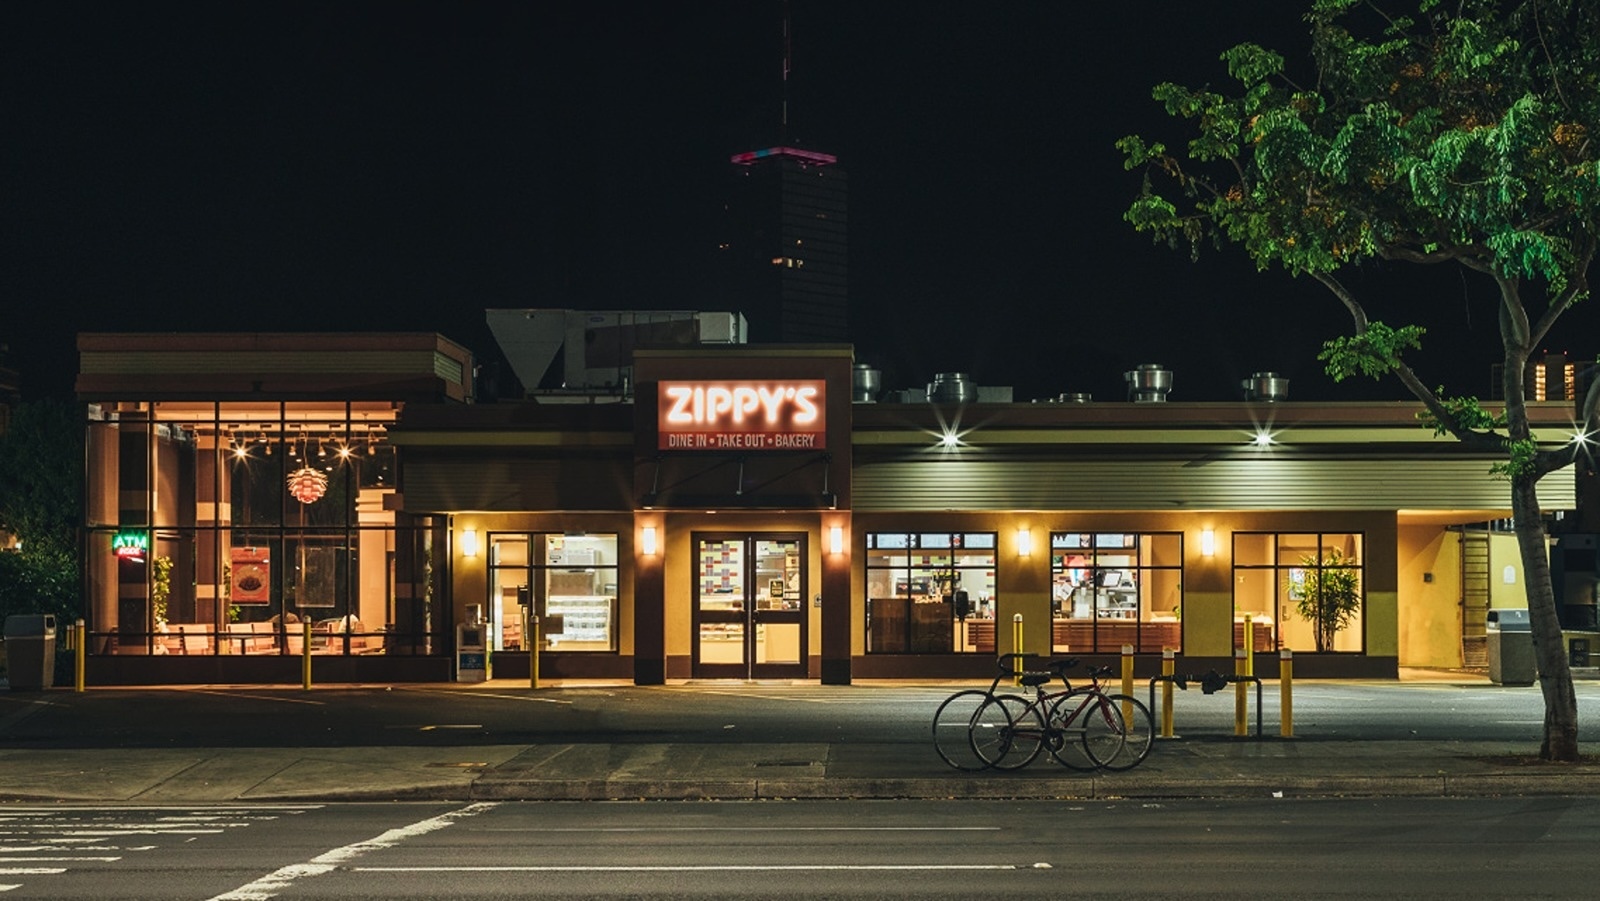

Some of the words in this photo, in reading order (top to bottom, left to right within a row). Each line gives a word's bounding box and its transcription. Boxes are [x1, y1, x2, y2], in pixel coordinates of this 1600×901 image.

[666, 386, 818, 423] ZIPPY'S
[669, 434, 693, 447] DINE
[696, 434, 707, 447] IN
[717, 434, 742, 447] TAKE
[745, 434, 765, 447] OUT
[775, 434, 815, 447] BAKERY
[113, 535, 147, 548] ATM
